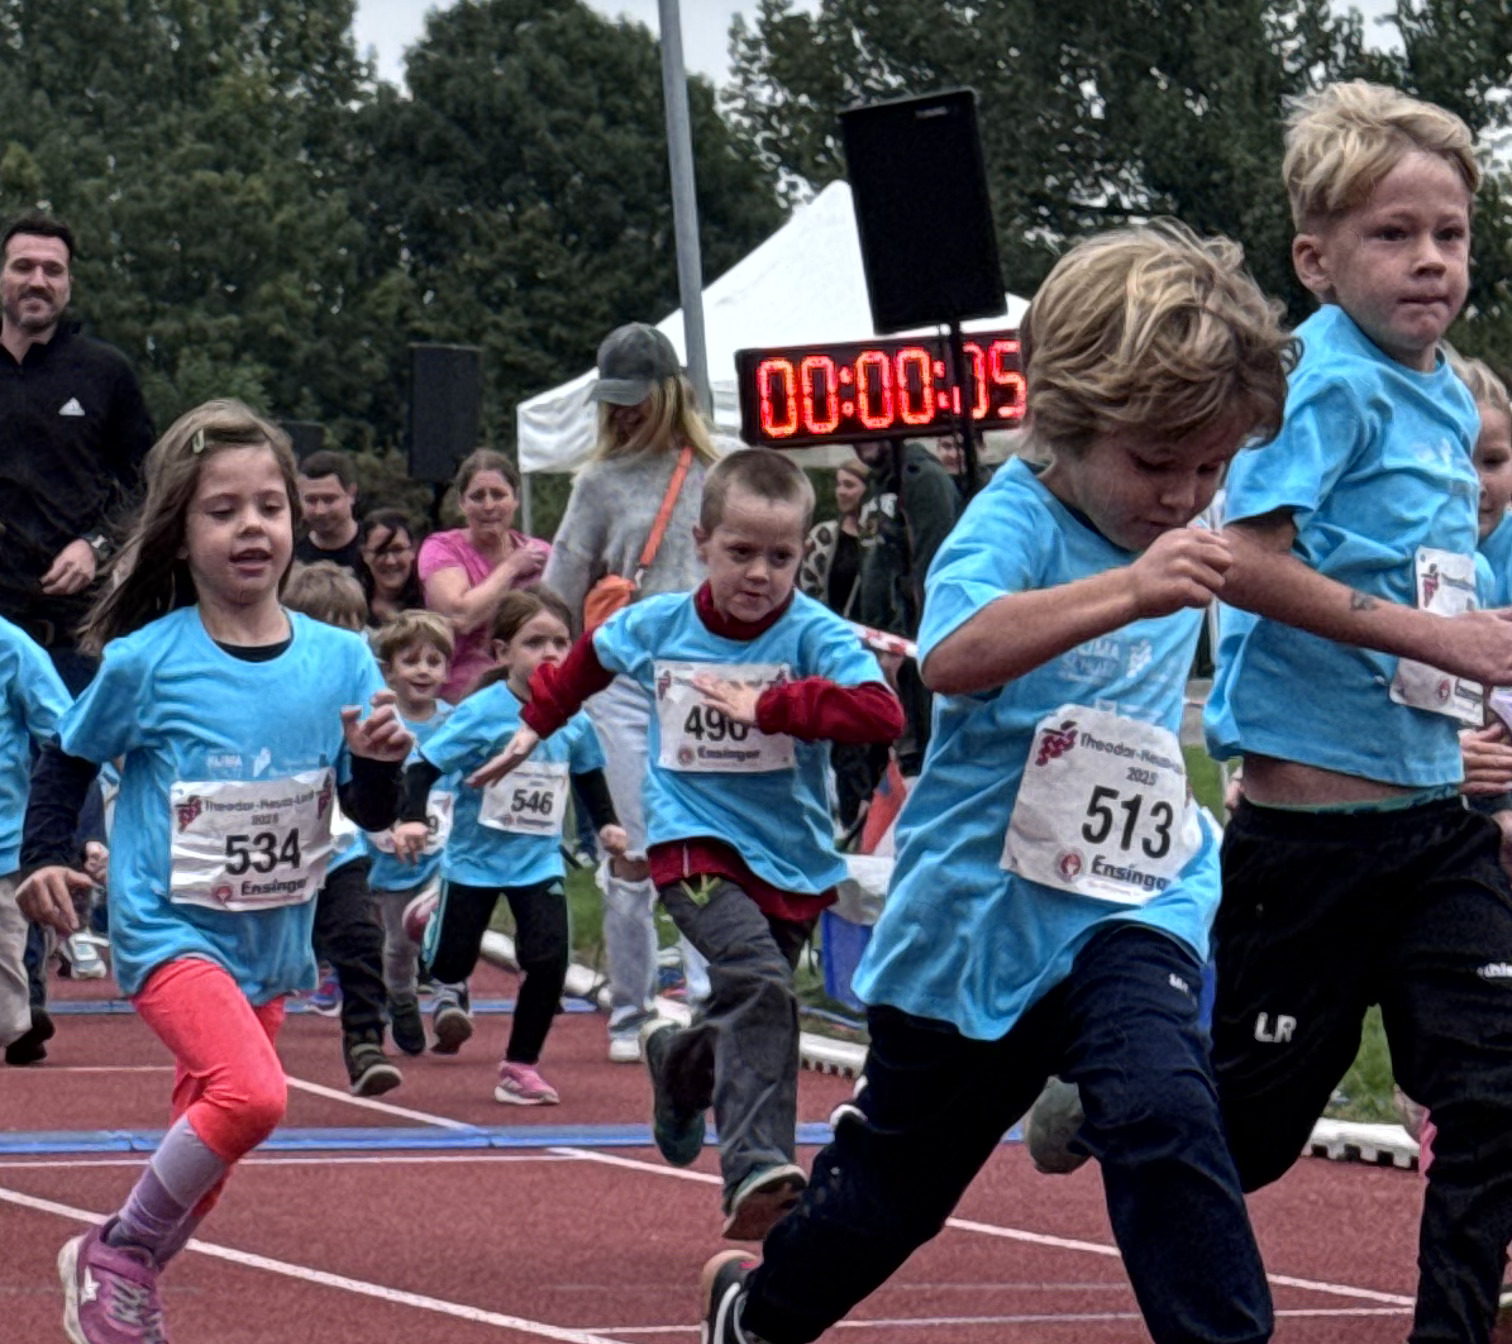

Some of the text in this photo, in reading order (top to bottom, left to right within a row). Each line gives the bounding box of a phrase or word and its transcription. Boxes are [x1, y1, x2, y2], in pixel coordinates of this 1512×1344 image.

[510, 788, 555, 816] 546
[1081, 784, 1174, 859] 513
[225, 827, 301, 875] 534
[1090, 854, 1172, 892] Ensinge
[1254, 1011, 1298, 1044] LR
